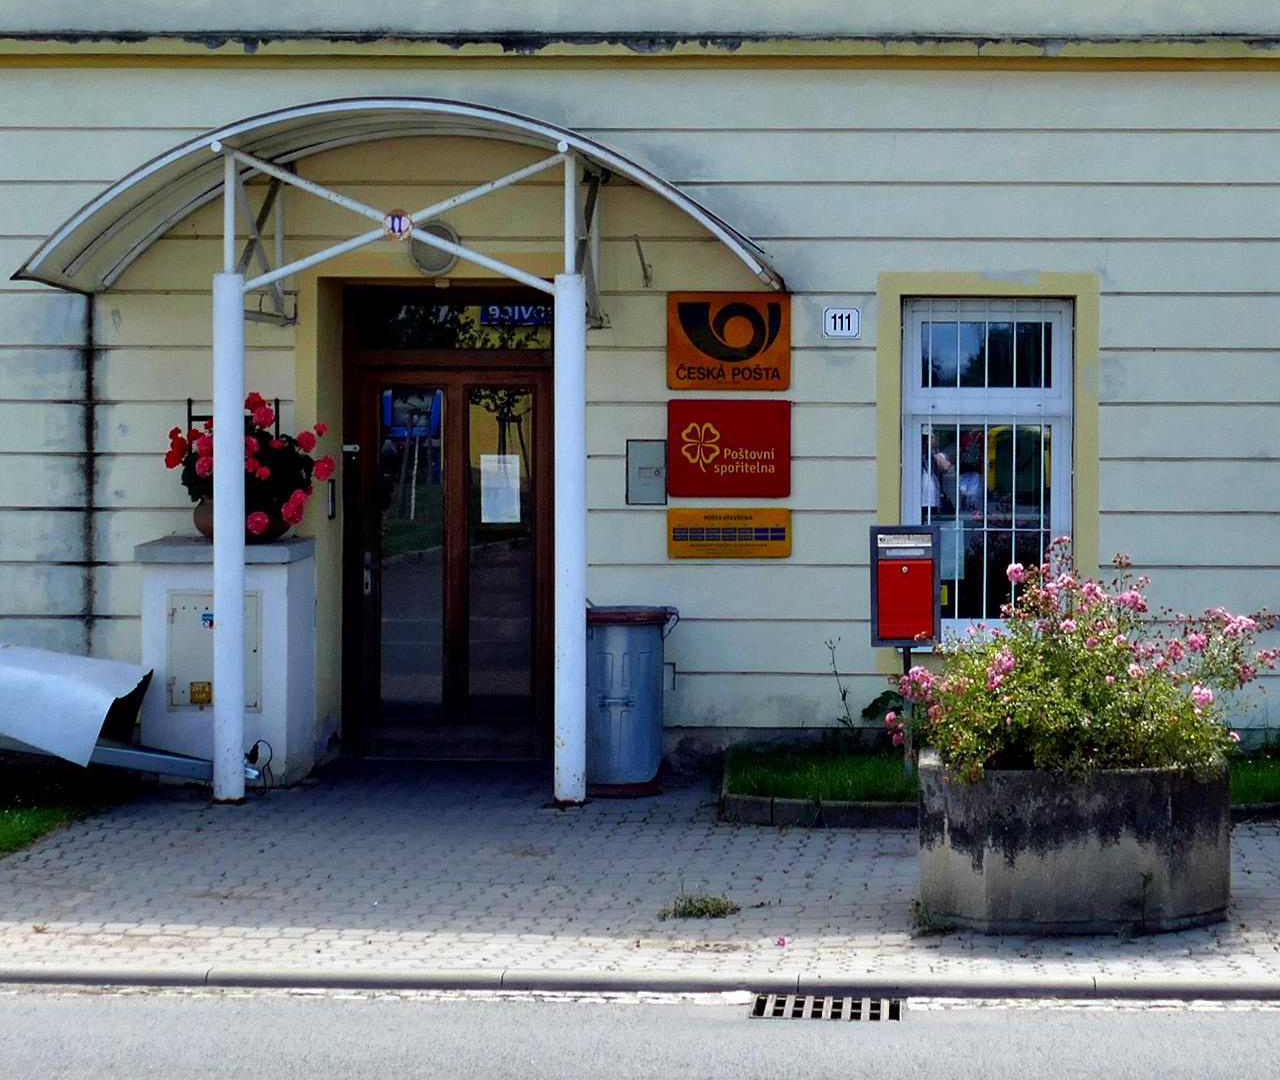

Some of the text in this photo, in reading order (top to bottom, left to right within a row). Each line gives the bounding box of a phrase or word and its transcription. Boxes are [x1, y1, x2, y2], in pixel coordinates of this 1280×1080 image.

[831, 313, 851, 331] 111
[676, 363, 781, 381] ČESKÁ POŠTA
[723, 447, 775, 460] Poštovní
[714, 461, 776, 476] spořitelna
